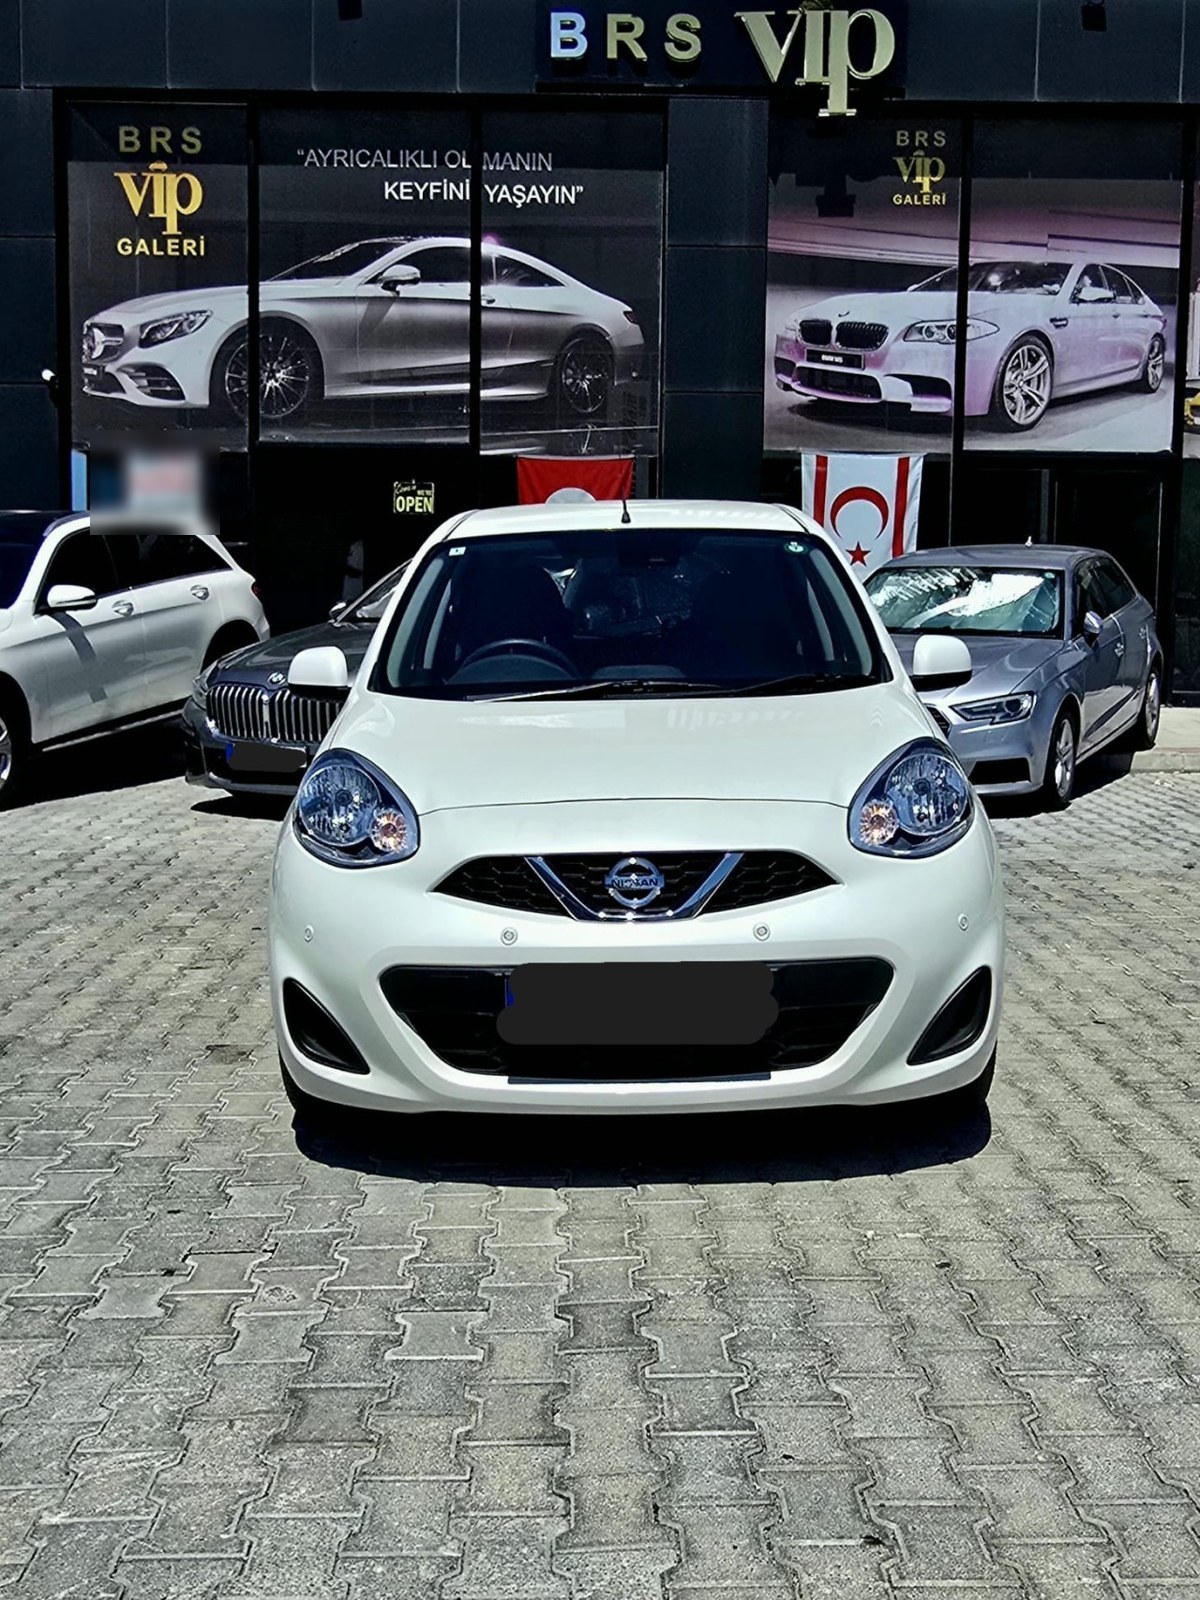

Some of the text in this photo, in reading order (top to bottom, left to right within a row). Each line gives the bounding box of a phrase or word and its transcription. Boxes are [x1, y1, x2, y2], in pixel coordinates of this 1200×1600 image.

[550, 12, 701, 62] BRS
[118, 125, 203, 154] BRS
[896, 130, 946, 147] BRS
[384, 178, 471, 200] KEYFİNİ
[892, 193, 946, 205] GALERİ
[117, 236, 205, 256] GALERİ
[396, 496, 433, 512] OPEN
